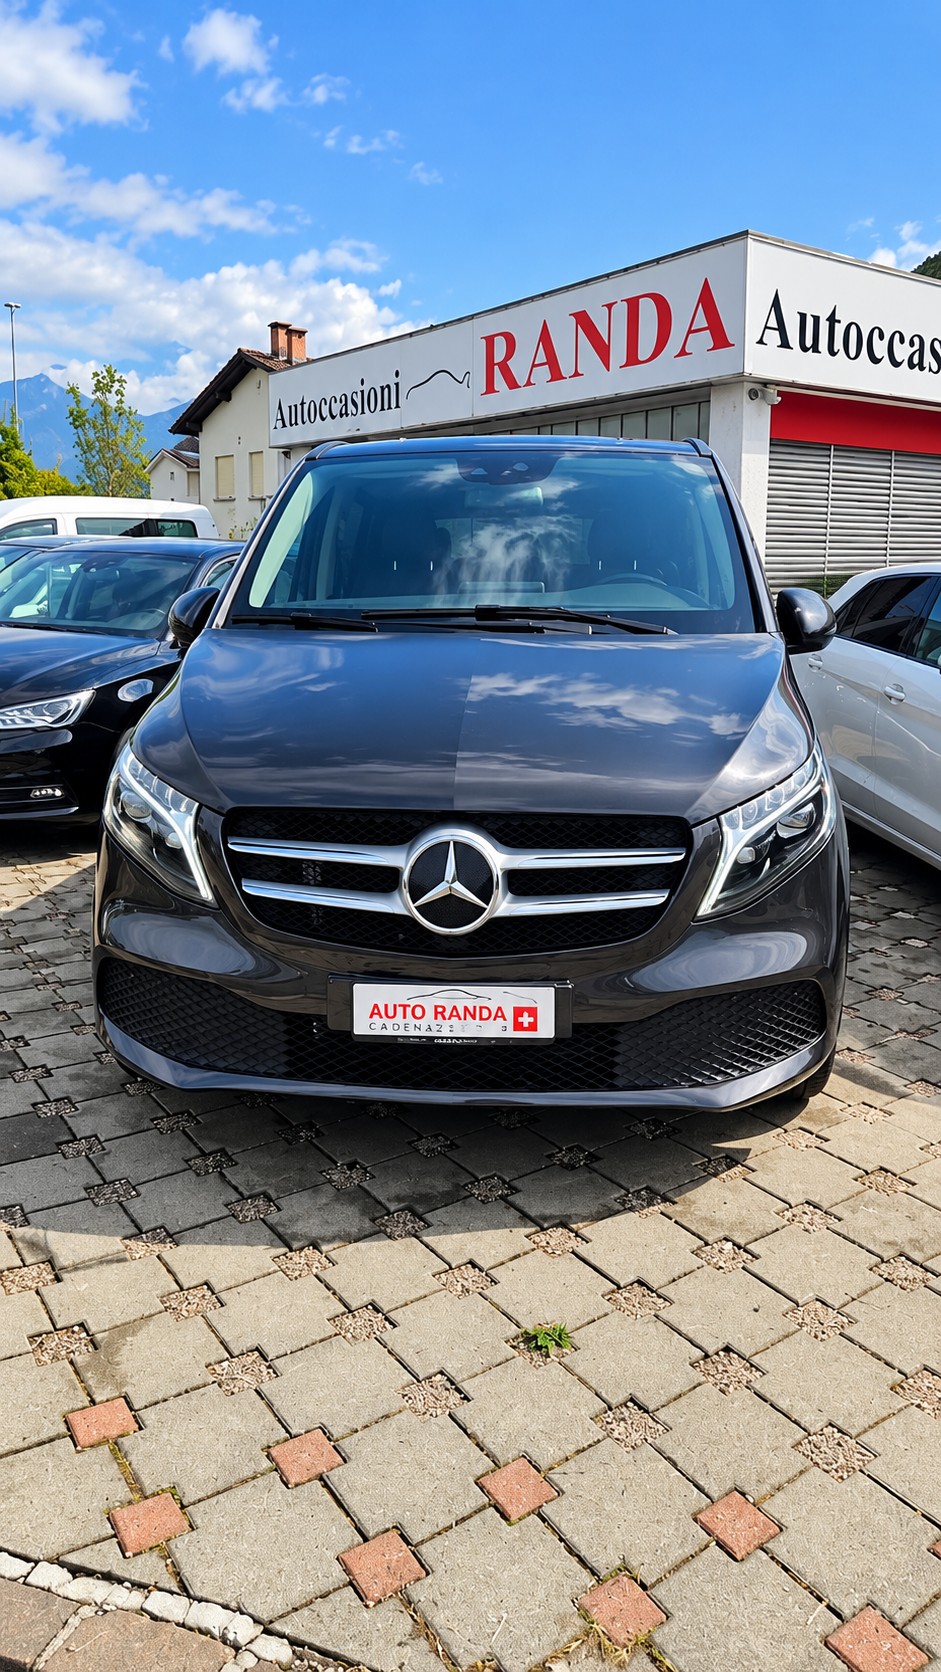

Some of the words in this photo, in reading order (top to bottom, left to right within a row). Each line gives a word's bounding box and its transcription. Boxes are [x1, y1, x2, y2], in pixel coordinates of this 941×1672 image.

[272, 369, 401, 430] Autoccasioni
[480, 277, 735, 396] RANDA
[755, 288, 941, 375] Autoccas
[368, 1003, 426, 1020] AUTO
[433, 1005, 508, 1021] RANDA
